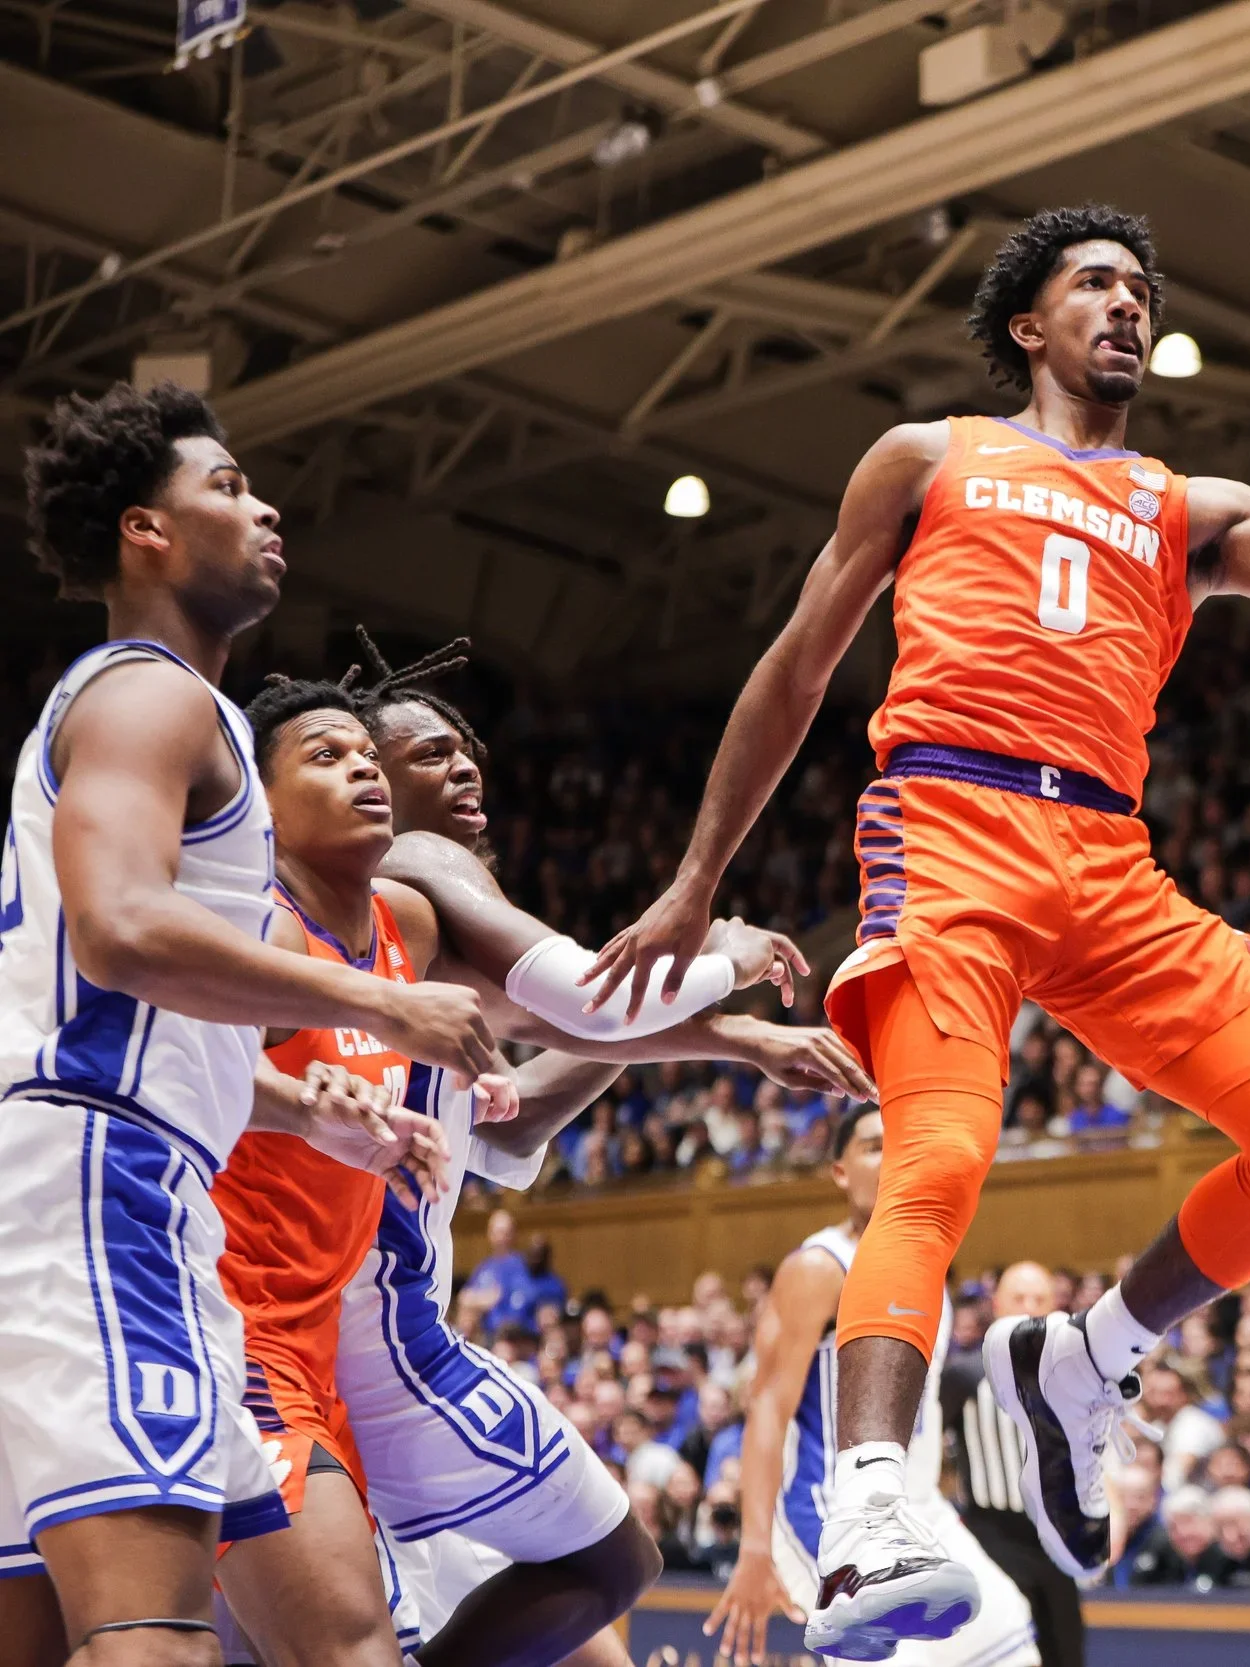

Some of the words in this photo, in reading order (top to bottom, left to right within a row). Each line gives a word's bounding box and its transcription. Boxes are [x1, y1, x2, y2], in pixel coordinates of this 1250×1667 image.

[965, 476, 1161, 568] CLEMSON
[1037, 532, 1091, 635] 0
[1040, 765, 1061, 799] C
[134, 1361, 196, 1417] D
[460, 1378, 515, 1435] D
